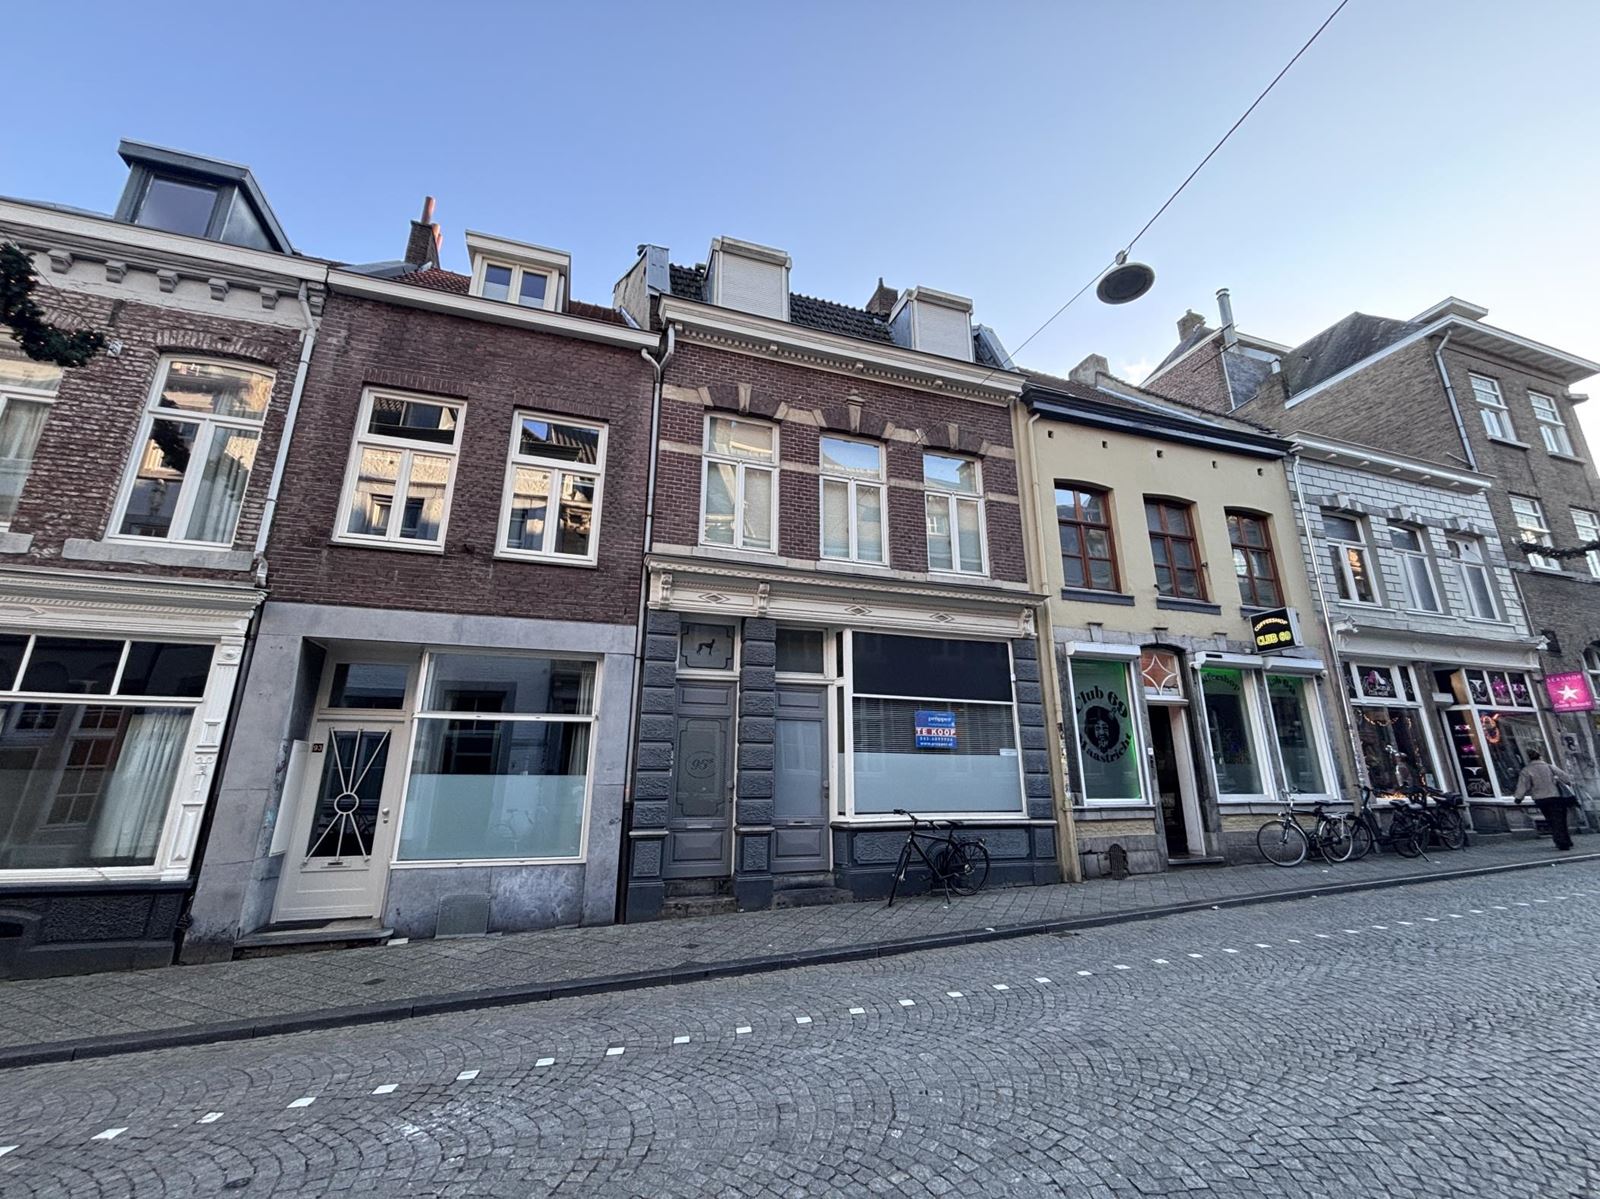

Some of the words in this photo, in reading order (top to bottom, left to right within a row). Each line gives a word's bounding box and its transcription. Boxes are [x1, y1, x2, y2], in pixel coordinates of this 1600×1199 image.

[1254, 617, 1288, 632] COFFEESHOP
[1256, 632, 1279, 646] CLUB
[1202, 672, 1240, 691] offeeshop
[1107, 691, 1128, 718] 69
[931, 728, 956, 736] KOOP
[313, 744, 322, 752] 93
